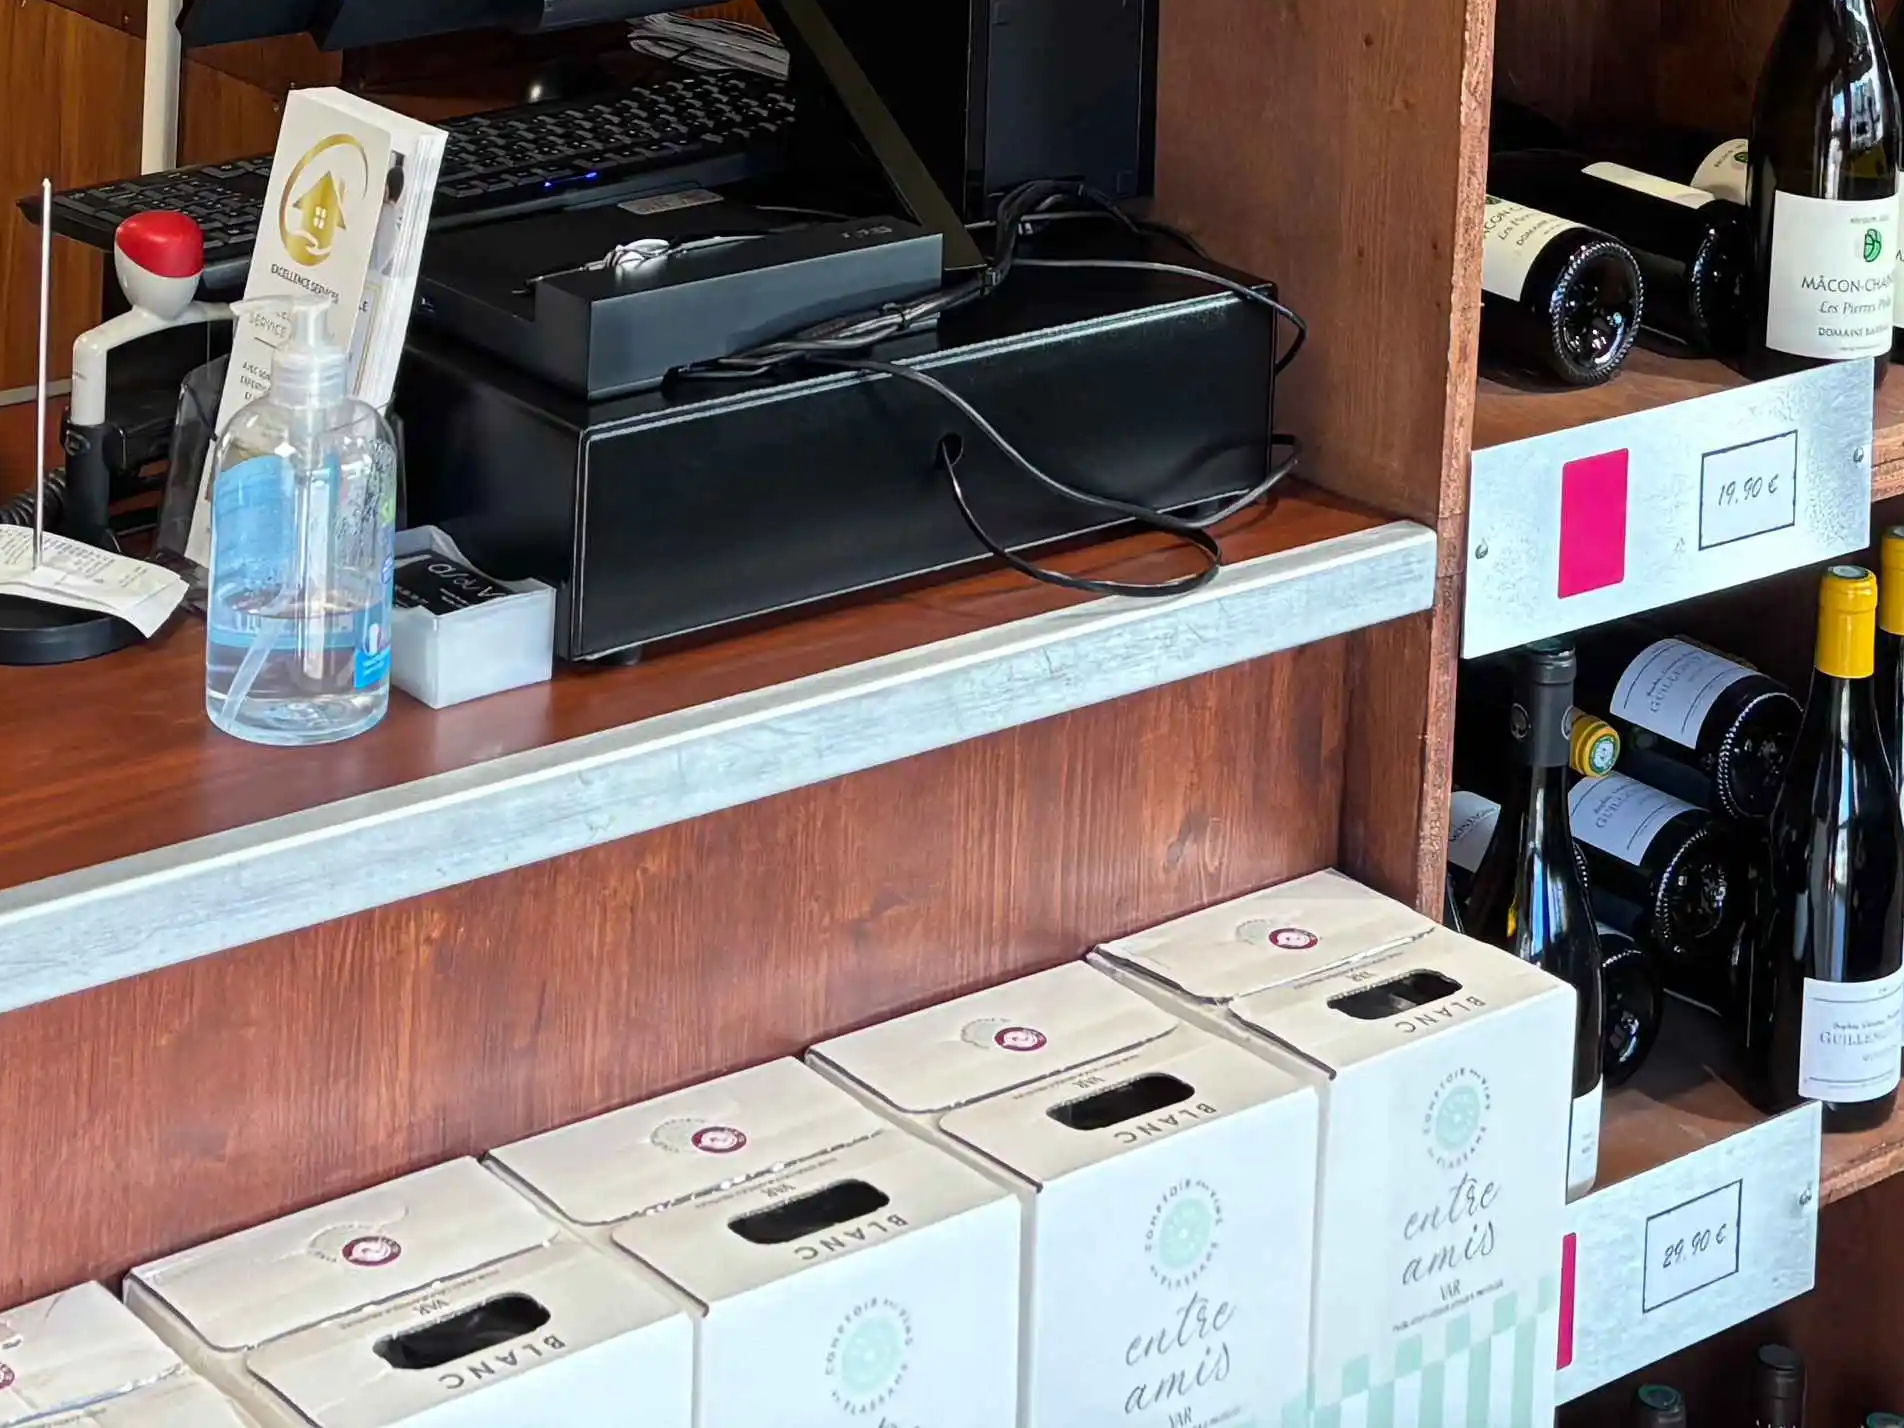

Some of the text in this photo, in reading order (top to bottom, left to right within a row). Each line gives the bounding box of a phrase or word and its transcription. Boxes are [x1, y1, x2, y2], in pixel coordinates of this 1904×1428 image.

[1394, 994, 1489, 1036] BLANC
[1112, 1101, 1217, 1147] BLANC
[1402, 1170, 1503, 1241] entre
[792, 1212, 910, 1266] BLANC
[1401, 1222, 1498, 1286] amis
[1125, 1290, 1239, 1366] entre
[444, 1332, 568, 1393] BLANC
[1123, 1340, 1233, 1416] amis
